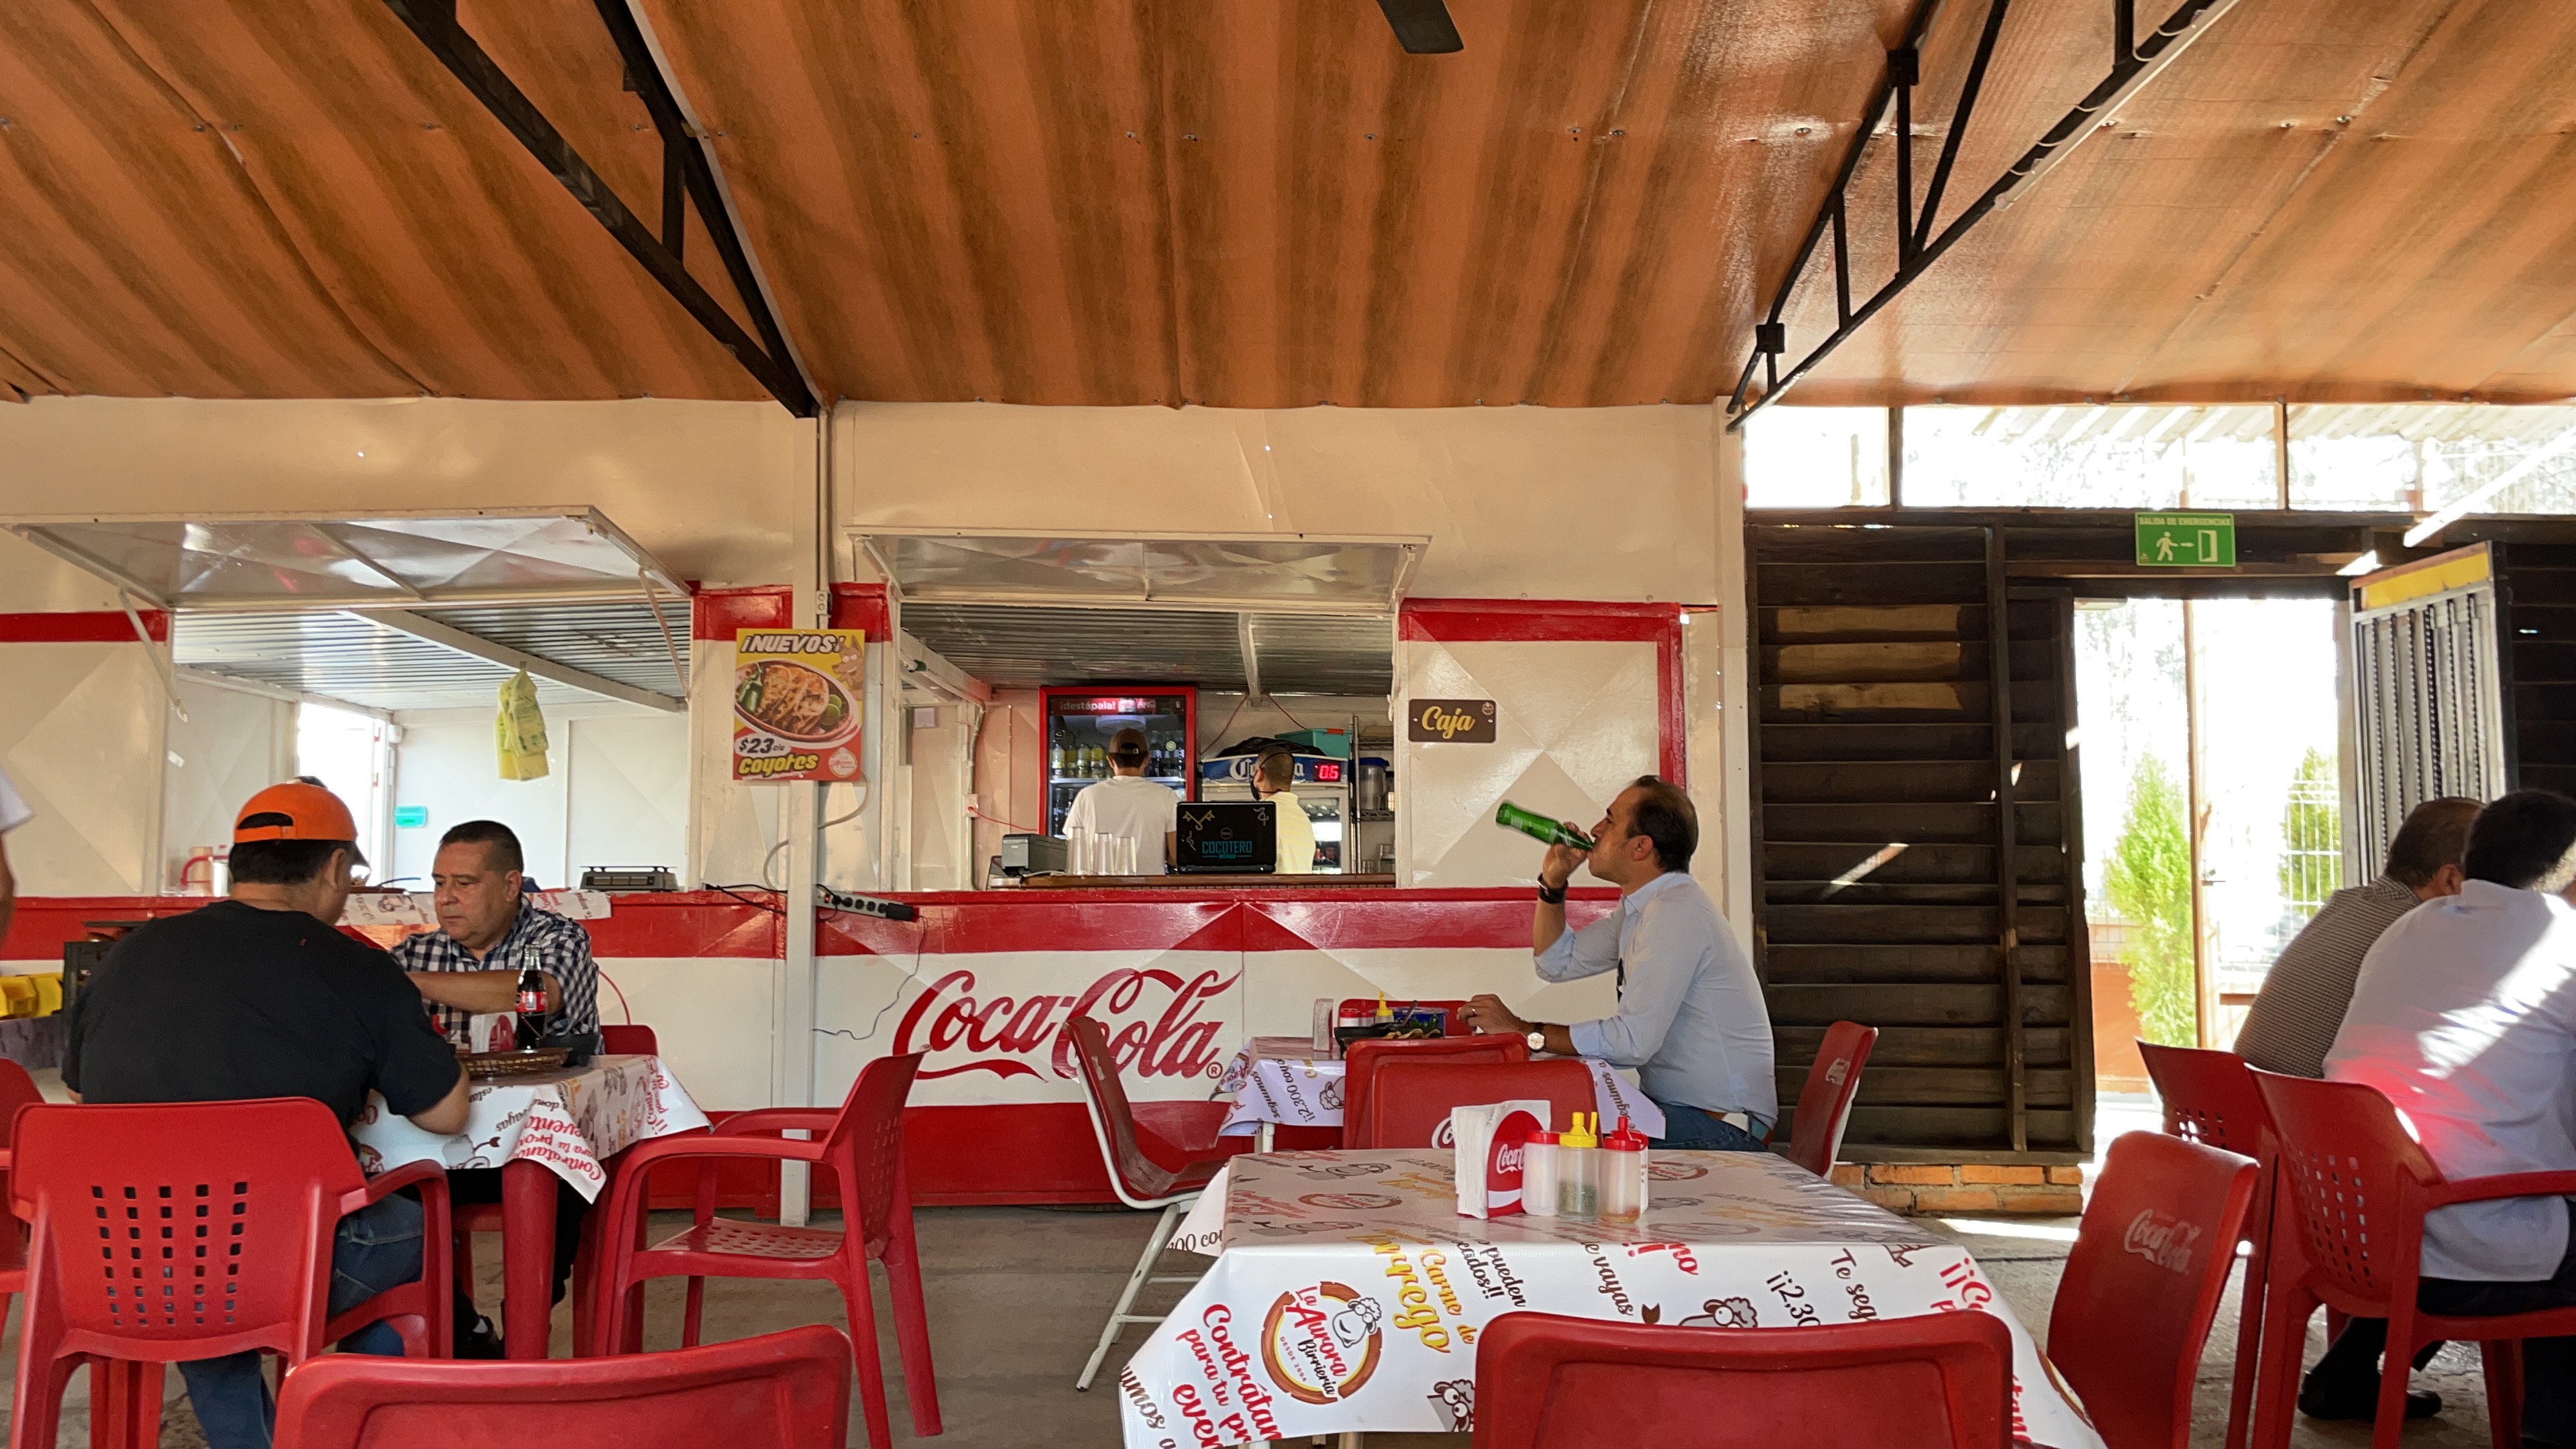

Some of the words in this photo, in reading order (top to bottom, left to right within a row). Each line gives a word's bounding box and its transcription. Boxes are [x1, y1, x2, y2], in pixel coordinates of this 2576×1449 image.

[1421, 706, 1475, 739] Caja
[739, 738, 774, 754] $23
[1202, 841, 1252, 853] COCOTERO
[893, 968, 1242, 1083] Coca-Cola
[1831, 1248, 1856, 1279] Te
[1295, 1286, 1318, 1306] La
[1419, 1248, 1462, 1316] Carne
[1456, 1324, 1477, 1344] de
[1593, 1256, 1633, 1316] vayas
[1280, 1336, 1296, 1361] DESDE
[1285, 1302, 1347, 1377] Aurora
[1175, 1329, 1219, 1380] para
[1212, 1379, 1229, 1406] tu
